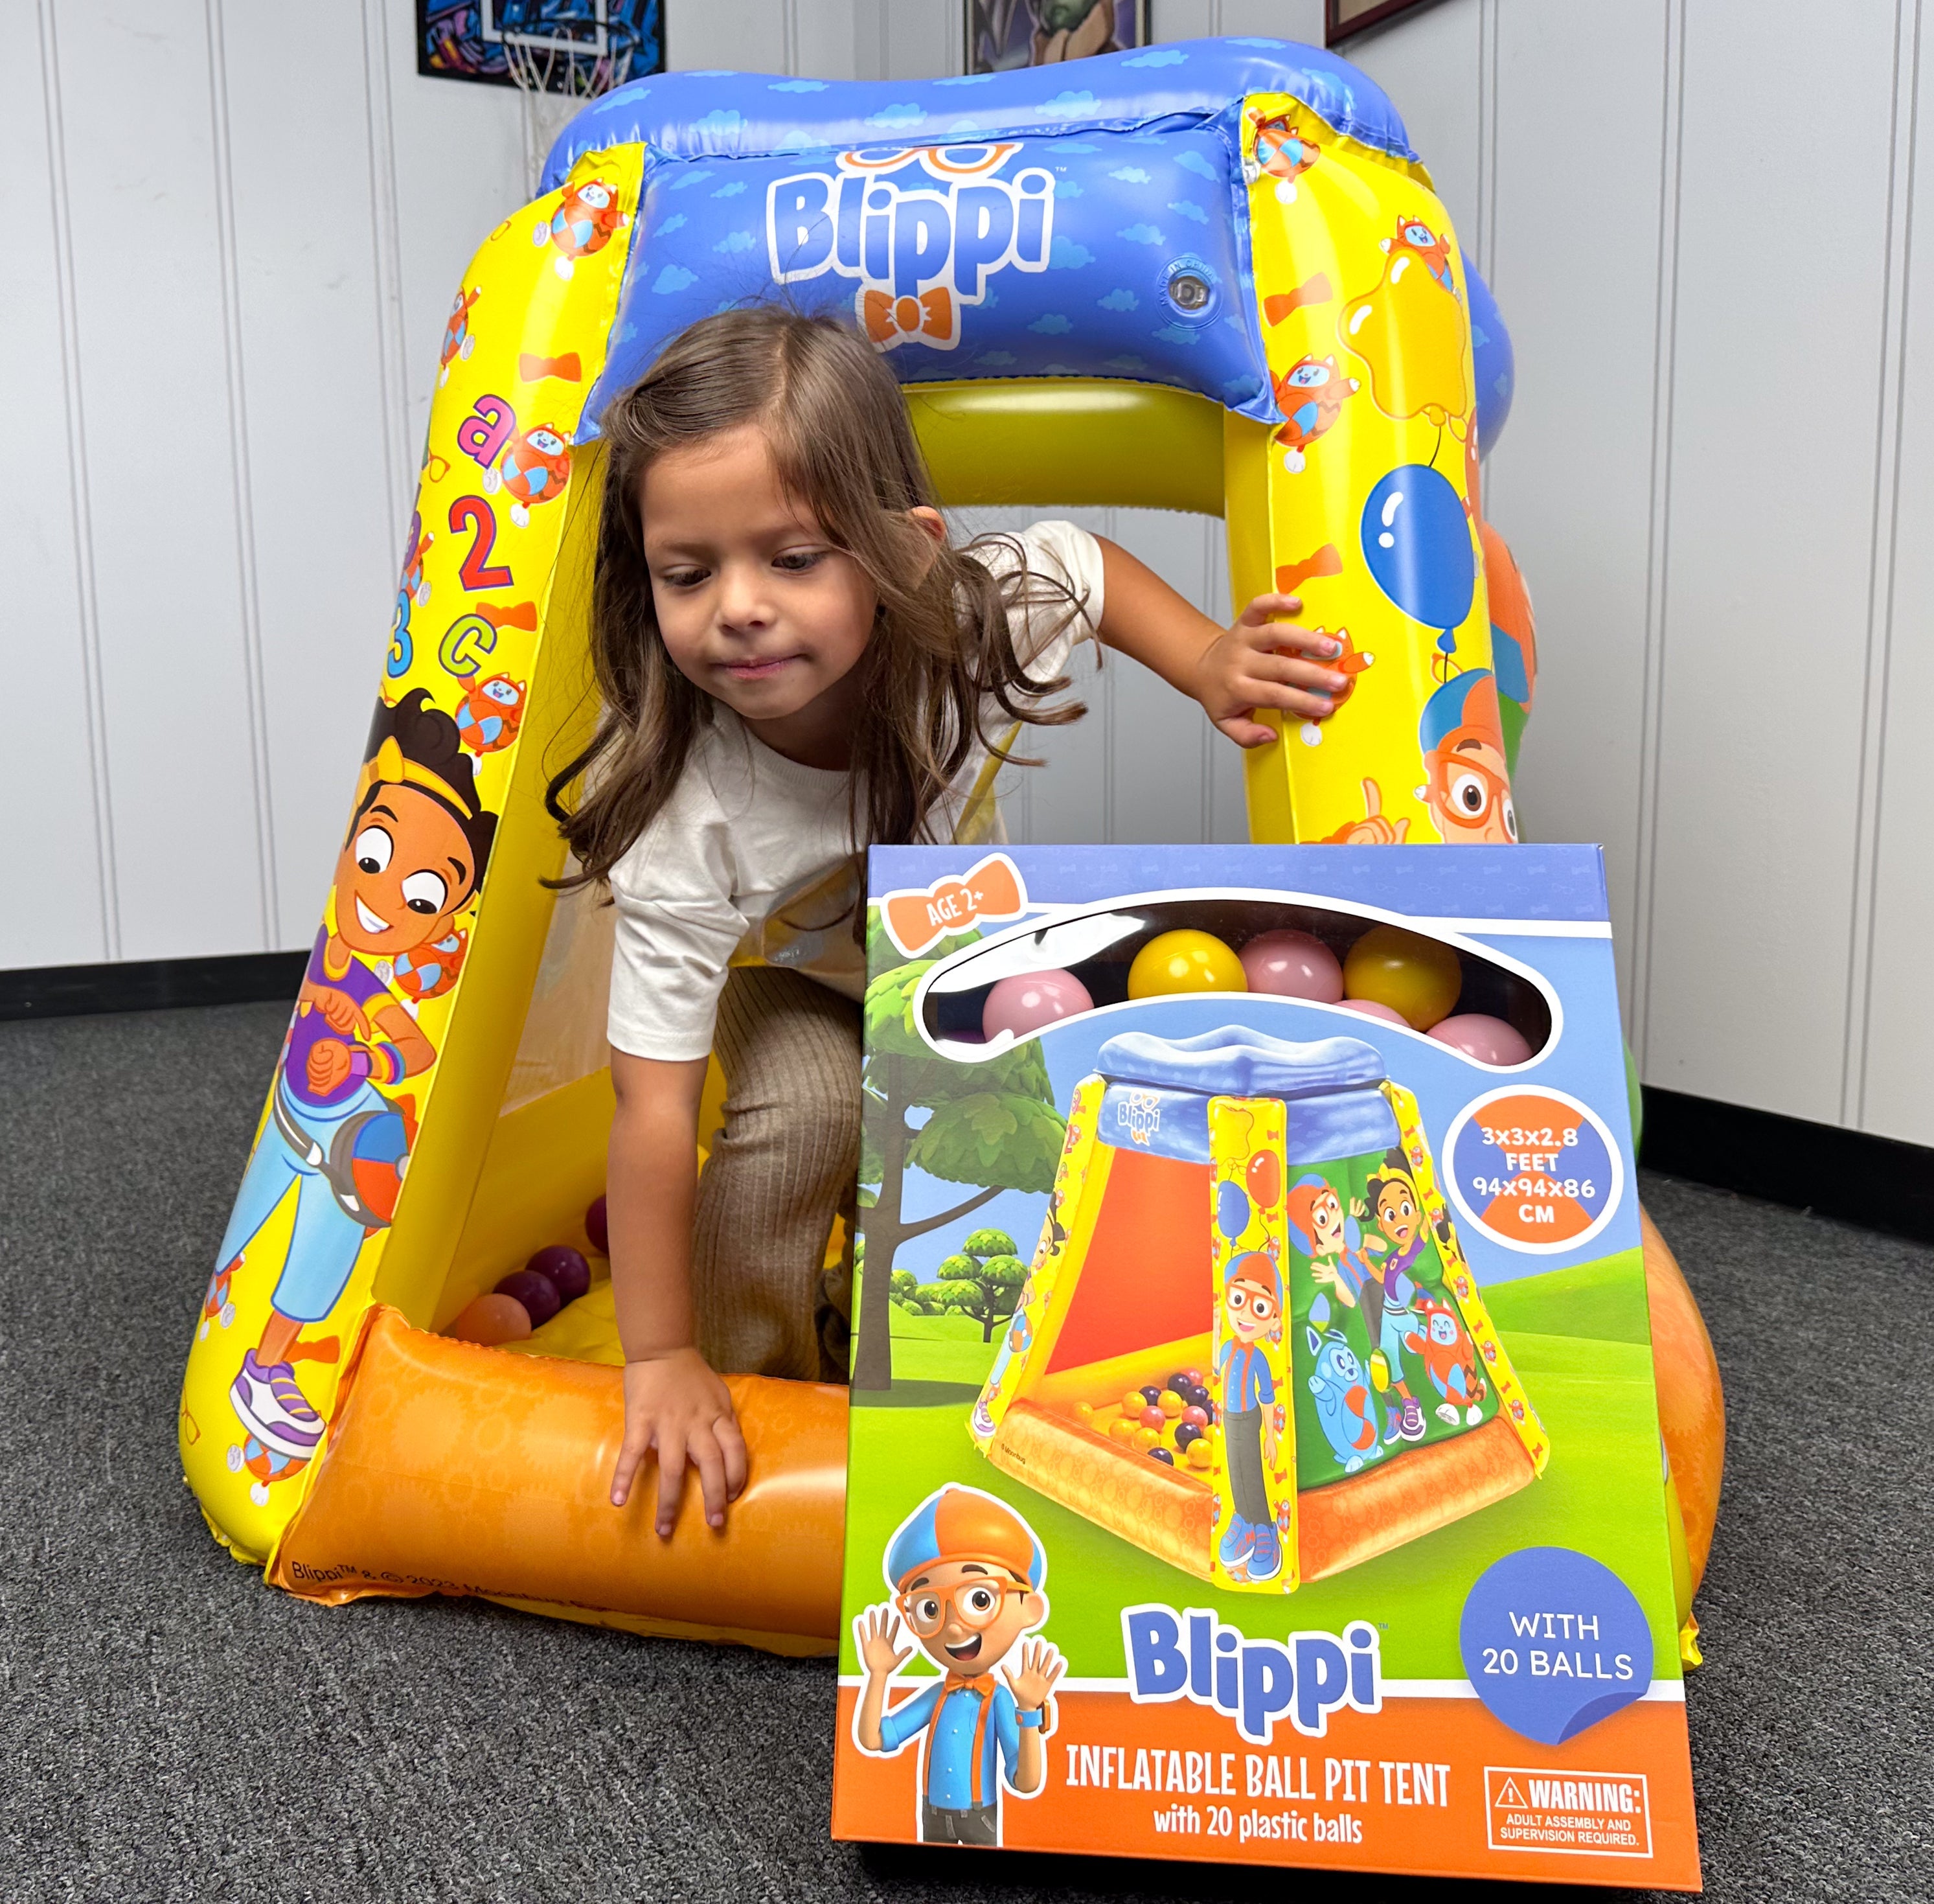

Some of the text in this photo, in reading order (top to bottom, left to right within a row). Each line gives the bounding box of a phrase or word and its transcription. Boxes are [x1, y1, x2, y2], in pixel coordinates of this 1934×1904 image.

[766, 167, 1056, 303] Blippi
[448, 495, 514, 591] 2
[926, 888, 984, 926] AGE 2+
[1117, 1101, 1160, 1134] Blippi
[1481, 1127, 1578, 1146] 3x3x2.8
[1505, 1153, 1559, 1171] FEET
[1472, 1176, 1596, 1198] 94x94x86
[1518, 1204, 1554, 1223] CM
[1508, 1611, 1599, 1640] WITH
[1128, 1611, 1374, 1737] Blippi
[1482, 1647, 1633, 1680] 20 BALLS
[1066, 1744, 1451, 1807] INFLATABLE BALL PIT TENT
[1528, 1779, 1642, 1813] WARNING:
[1153, 1803, 1363, 1844] with 20 plastic balls
[1500, 1827, 1640, 1846] SUPERVISION REQUIRED.
[1506, 1813, 1632, 1831] ADULT ASSEMBLY AND
